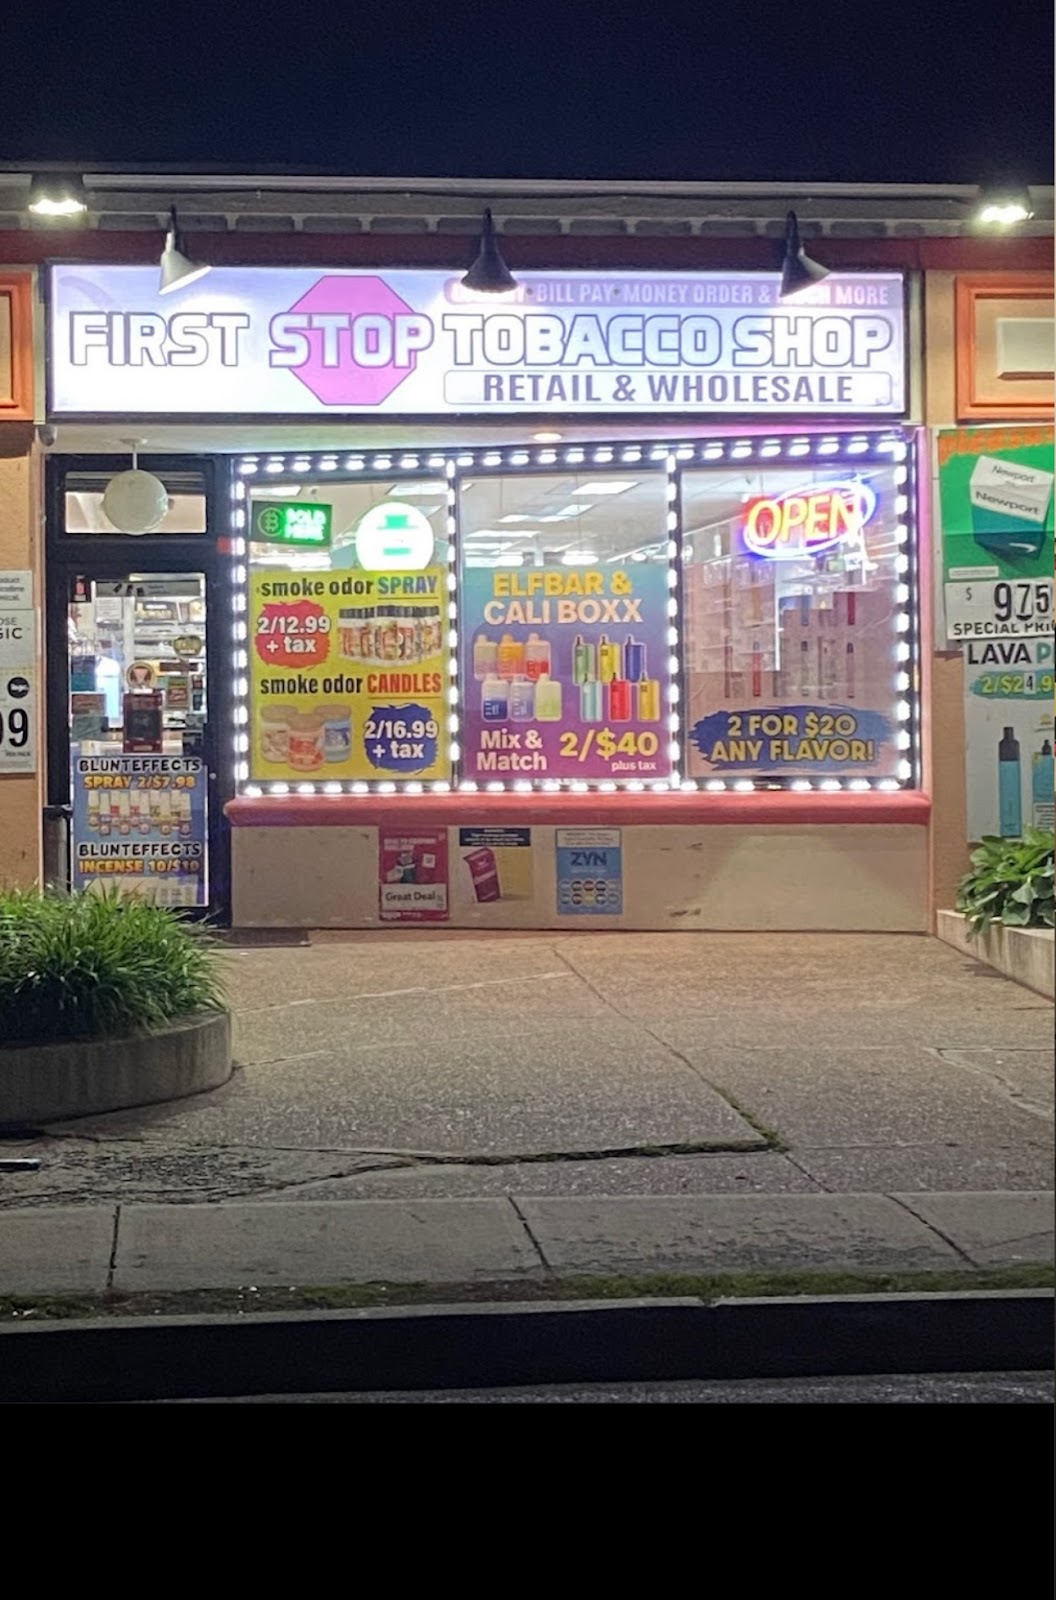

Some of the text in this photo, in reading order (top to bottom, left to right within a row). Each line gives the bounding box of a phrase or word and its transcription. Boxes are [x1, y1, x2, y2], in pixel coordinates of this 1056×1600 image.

[536, 283, 574, 303] BILL
[580, 283, 615, 303] PAY
[624, 284, 689, 303] MONEY
[693, 284, 753, 304] ORDER
[759, 285, 771, 304] &
[835, 285, 889, 305] MORE
[69, 311, 893, 368] FIRST STOP TOBACCO SHOP
[483, 374, 853, 402] RETAIL & WHOLESALE
[992, 466, 1035, 483] Newport
[975, 490, 1039, 514] Newport
[747, 494, 862, 546] OPEN
[261, 575, 439, 597] smoke odor SPRAY
[493, 571, 633, 597] ELFBAR &
[484, 598, 643, 625] CALI BOXX
[257, 615, 332, 635] 2/12.99
[953, 622, 1019, 636] SPECIAL
[266, 635, 317, 654] + tax
[968, 643, 1032, 665] LAVA
[260, 673, 442, 694] smoke odor CANDLES
[364, 720, 440, 740] 2/16.99
[727, 711, 858, 740] 2 FOR $20
[480, 728, 544, 750] Mix &
[559, 727, 659, 762] 2/$40
[372, 740, 425, 759] + tax
[710, 739, 875, 763] ANY FLAVOR!
[79, 758, 201, 773] BLUNTEFFECTS
[477, 751, 548, 771] Match
[611, 760, 657, 772] plus tax
[84, 774, 197, 790] SPRAY 2/$7.98
[79, 843, 201, 857] BLUNTEFFECTS
[570, 851, 608, 866] ZYN
[79, 859, 143, 873] INCENSE
[386, 891, 435, 901] Great Deal
